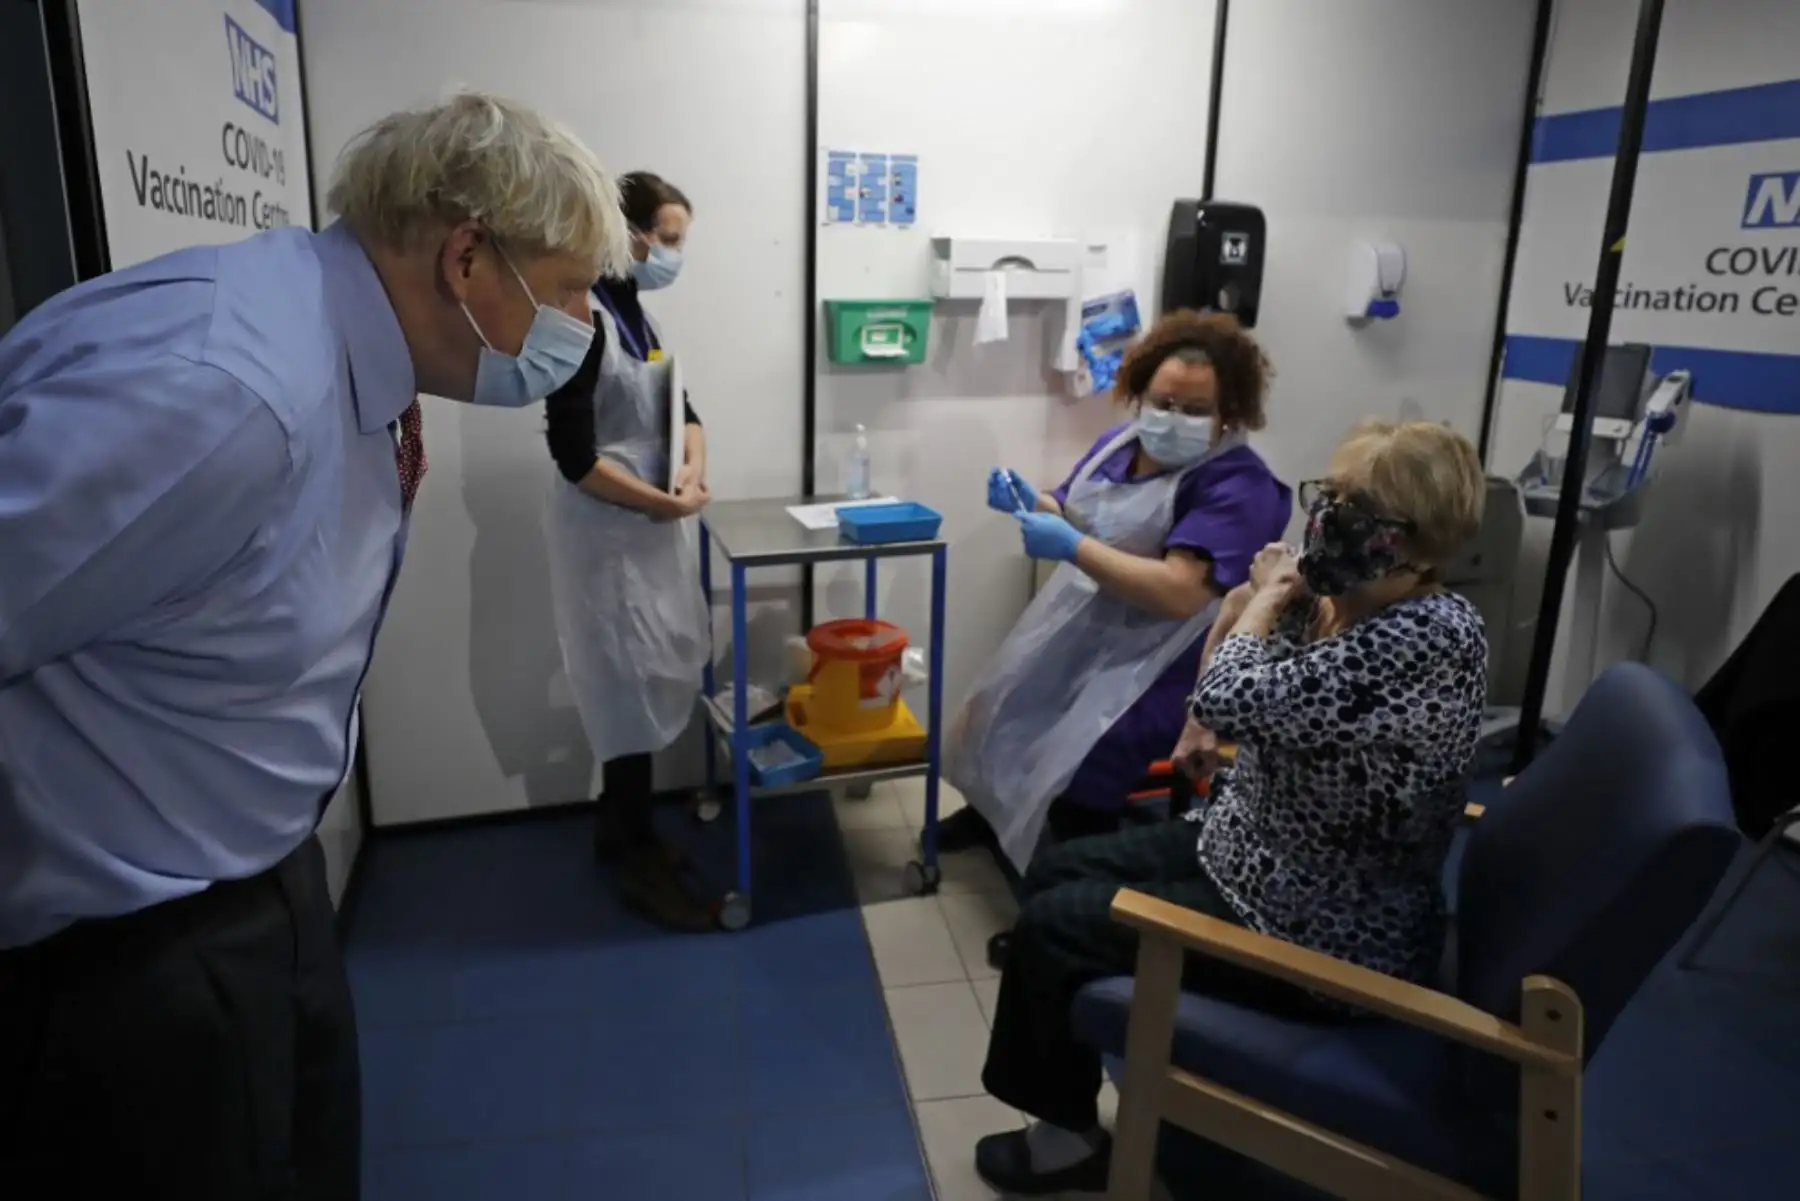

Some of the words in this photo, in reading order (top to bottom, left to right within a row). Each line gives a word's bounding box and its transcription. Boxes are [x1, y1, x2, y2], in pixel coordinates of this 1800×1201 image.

[226, 20, 278, 119] NHS
[222, 121, 285, 187] COVID-19
[127, 149, 247, 227] Vaccination
[1705, 246, 1800, 276] COVI
[1564, 281, 1739, 313] Vacination
